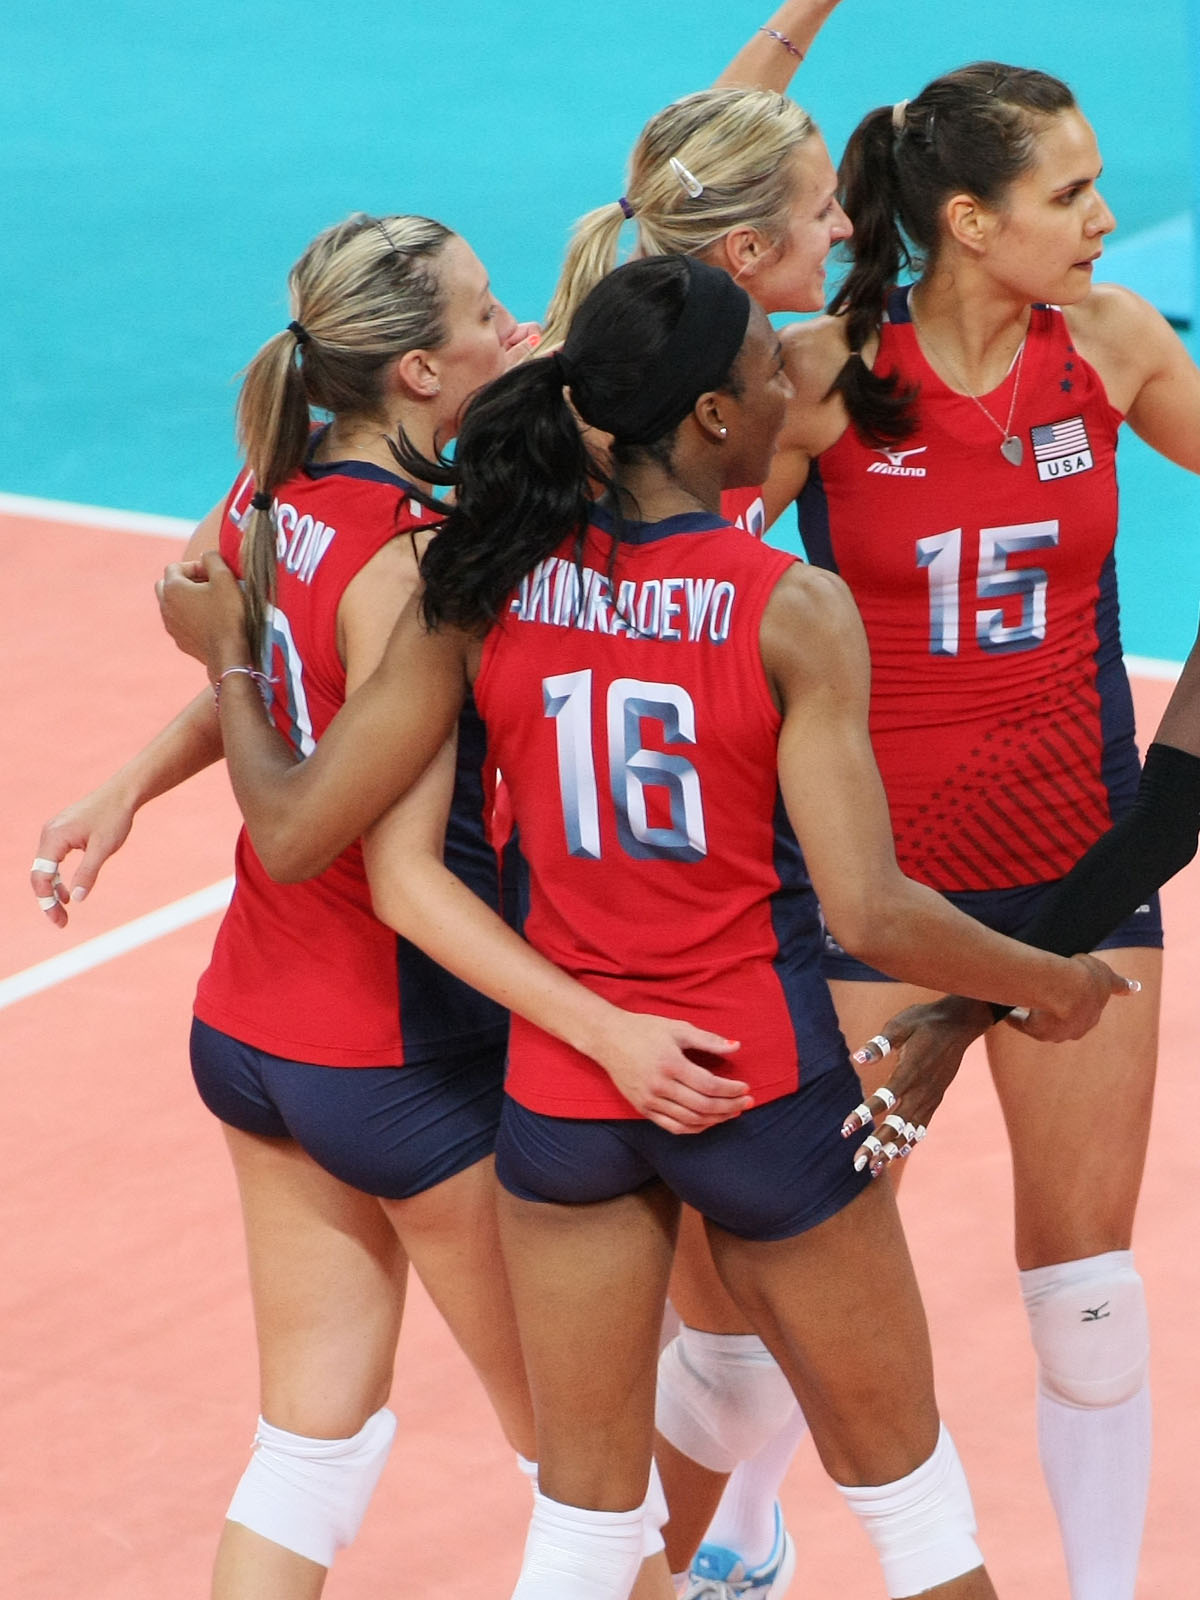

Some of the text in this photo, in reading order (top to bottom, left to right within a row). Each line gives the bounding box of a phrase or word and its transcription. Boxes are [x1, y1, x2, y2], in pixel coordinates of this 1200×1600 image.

[866, 462, 926, 477] MIZUNO
[1047, 455, 1086, 476] USA
[229, 469, 336, 586] LSON
[916, 519, 1060, 657] 15
[541, 669, 708, 864] 16
